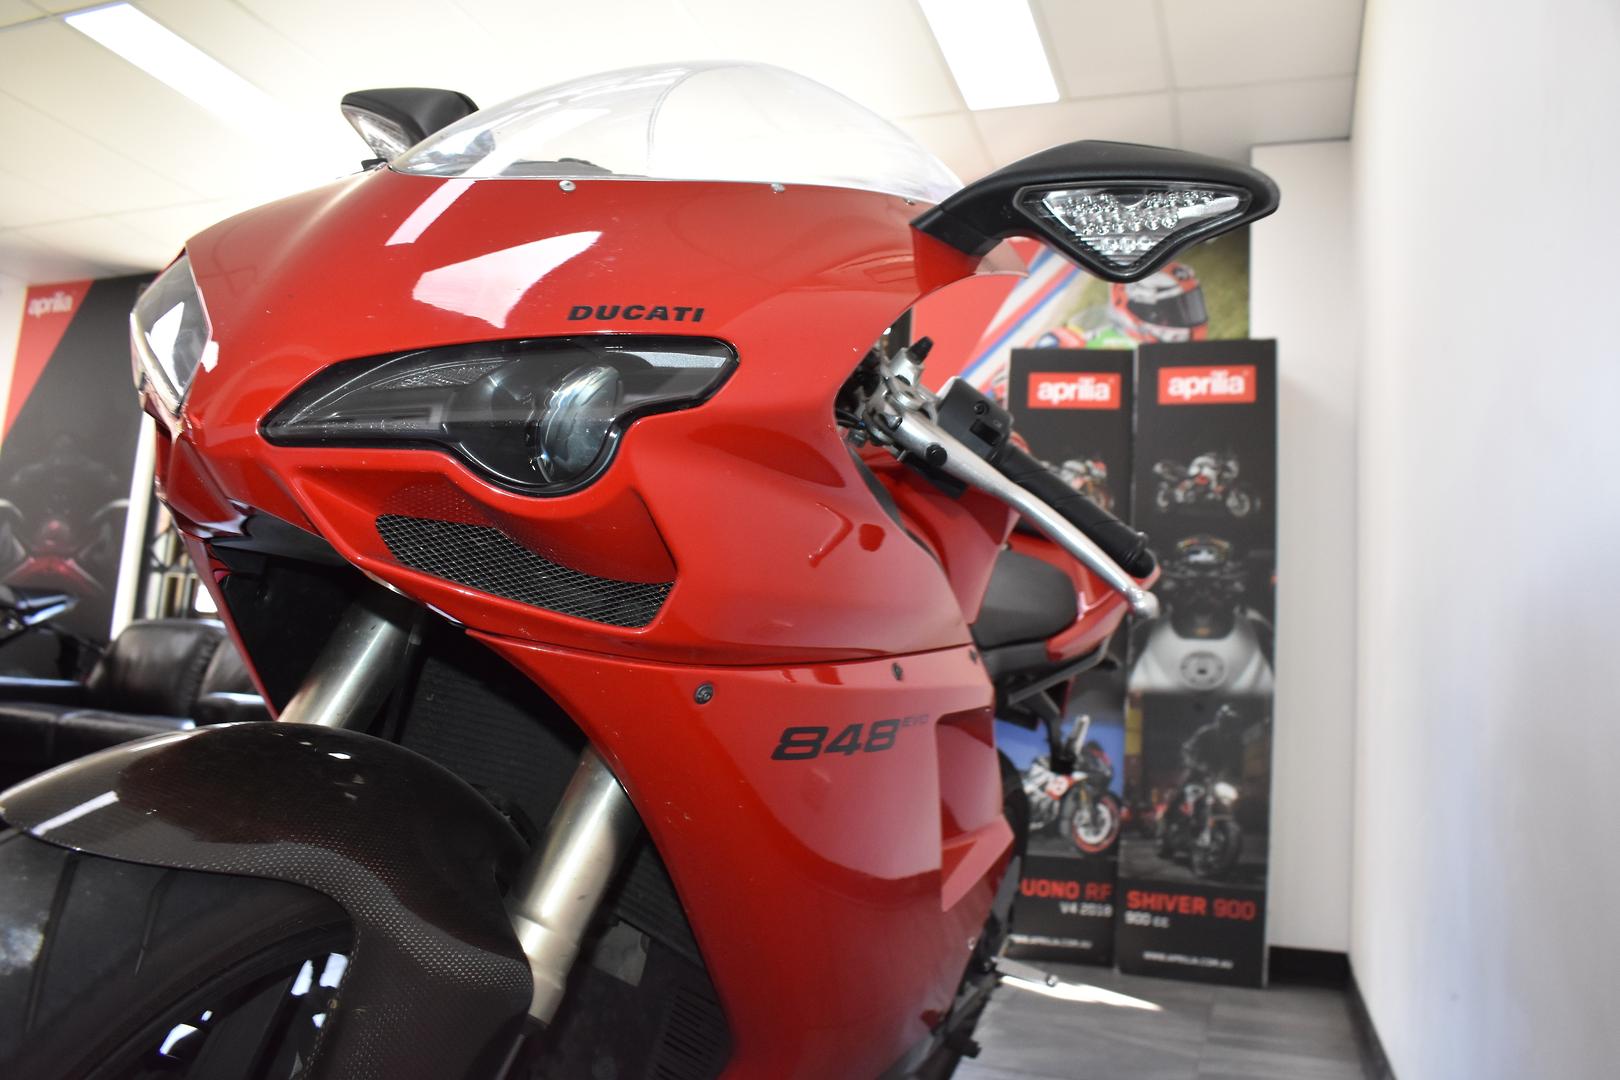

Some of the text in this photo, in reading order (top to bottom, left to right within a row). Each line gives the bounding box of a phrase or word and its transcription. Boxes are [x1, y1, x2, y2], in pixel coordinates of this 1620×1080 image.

[28, 291, 73, 318] aprilia
[567, 304, 705, 322] DUCATI
[1037, 376, 1111, 405] aprilia
[1168, 370, 1246, 400] aprilia
[770, 719, 900, 761] 848
[1019, 879, 1080, 900] UONO
[1126, 890, 1257, 921] SHIVER 900
